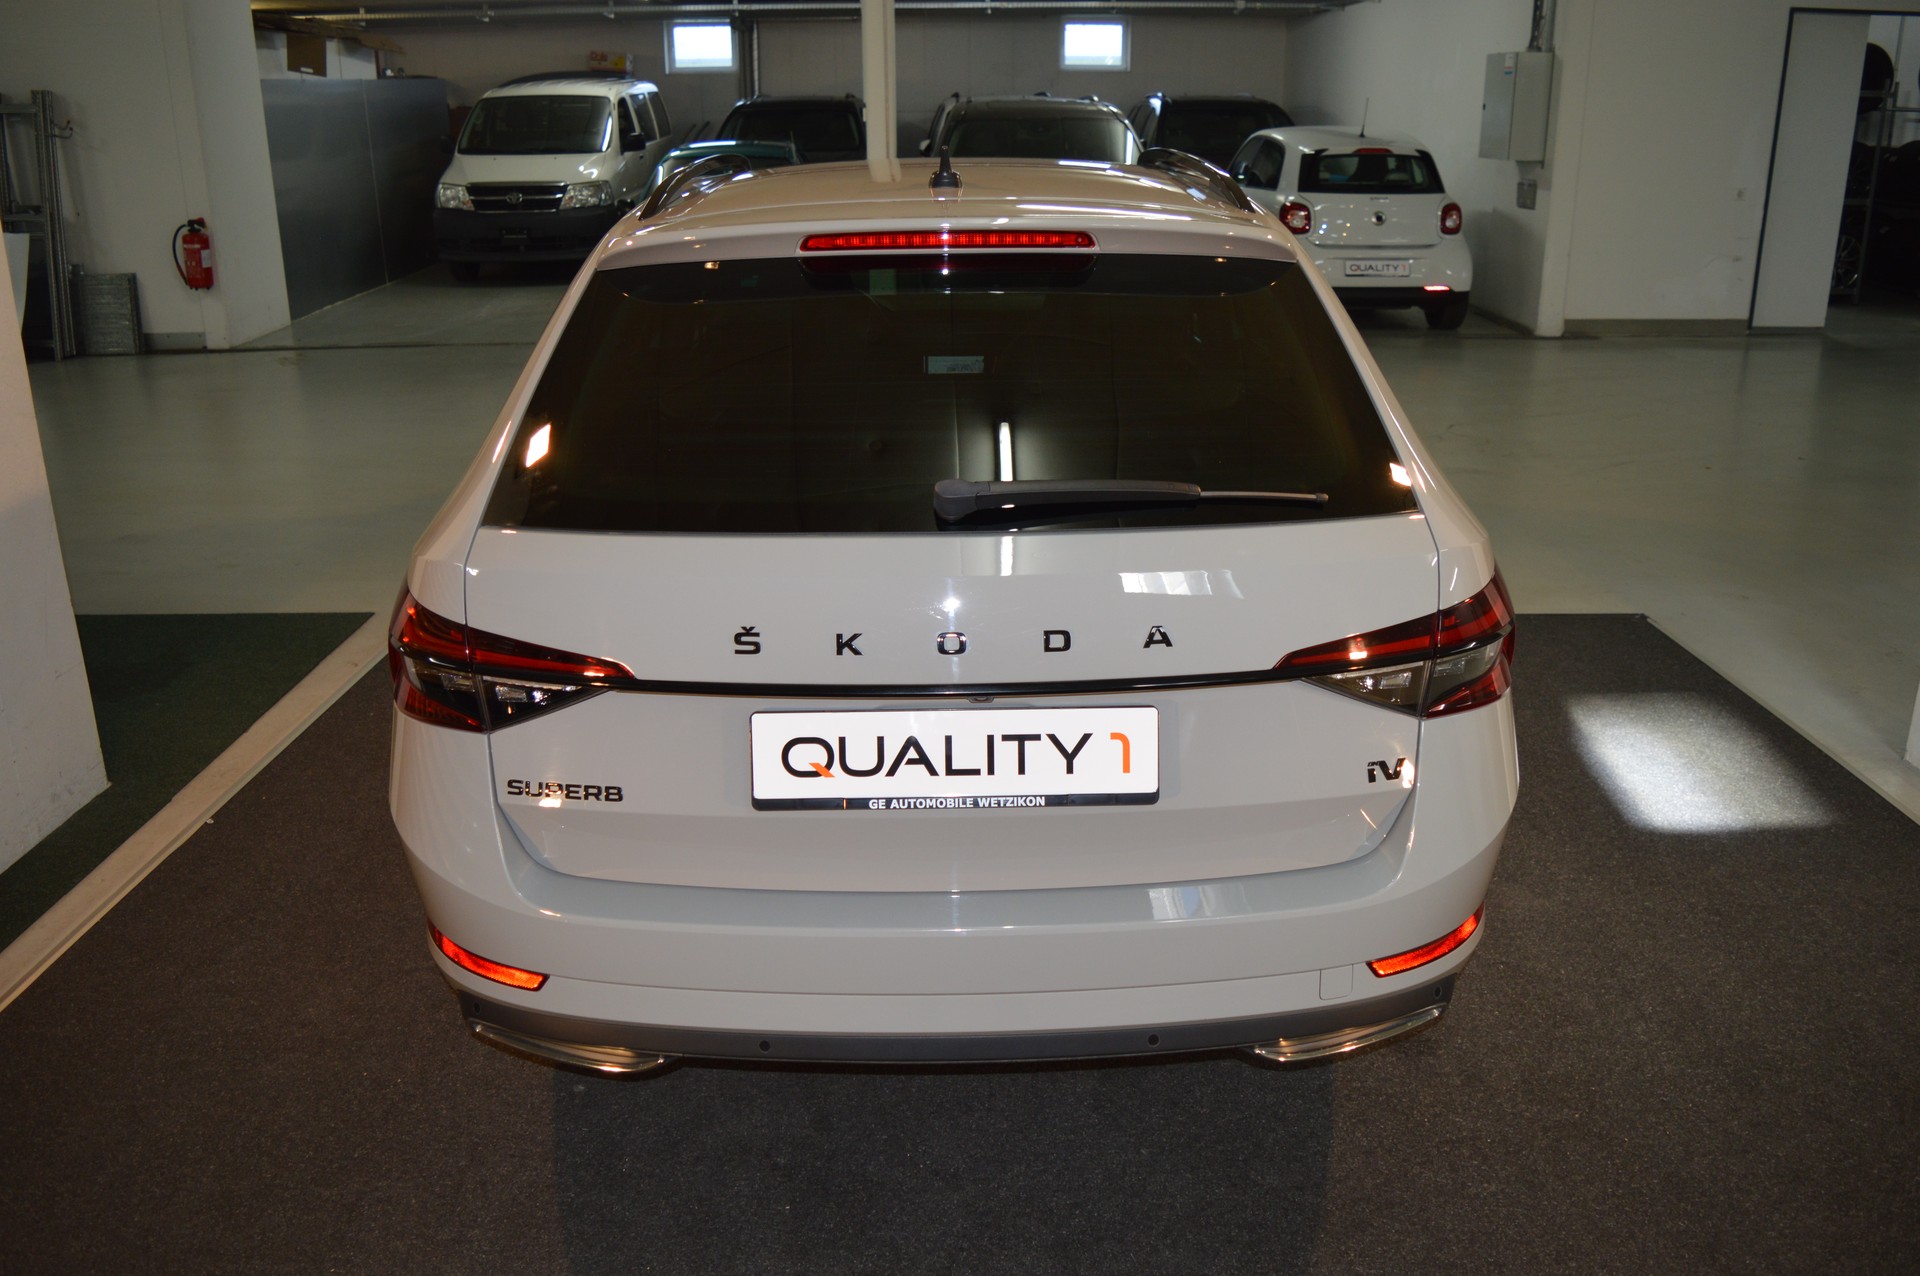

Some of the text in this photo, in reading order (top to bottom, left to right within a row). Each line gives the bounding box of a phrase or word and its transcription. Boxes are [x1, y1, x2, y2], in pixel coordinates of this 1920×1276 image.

[1349, 264, 1400, 272] QUALITY
[781, 732, 1131, 778] QUALITY 1
[507, 779, 623, 802] SUPERB
[868, 796, 1046, 809] GE AUTOMOBILE WETZIKON
